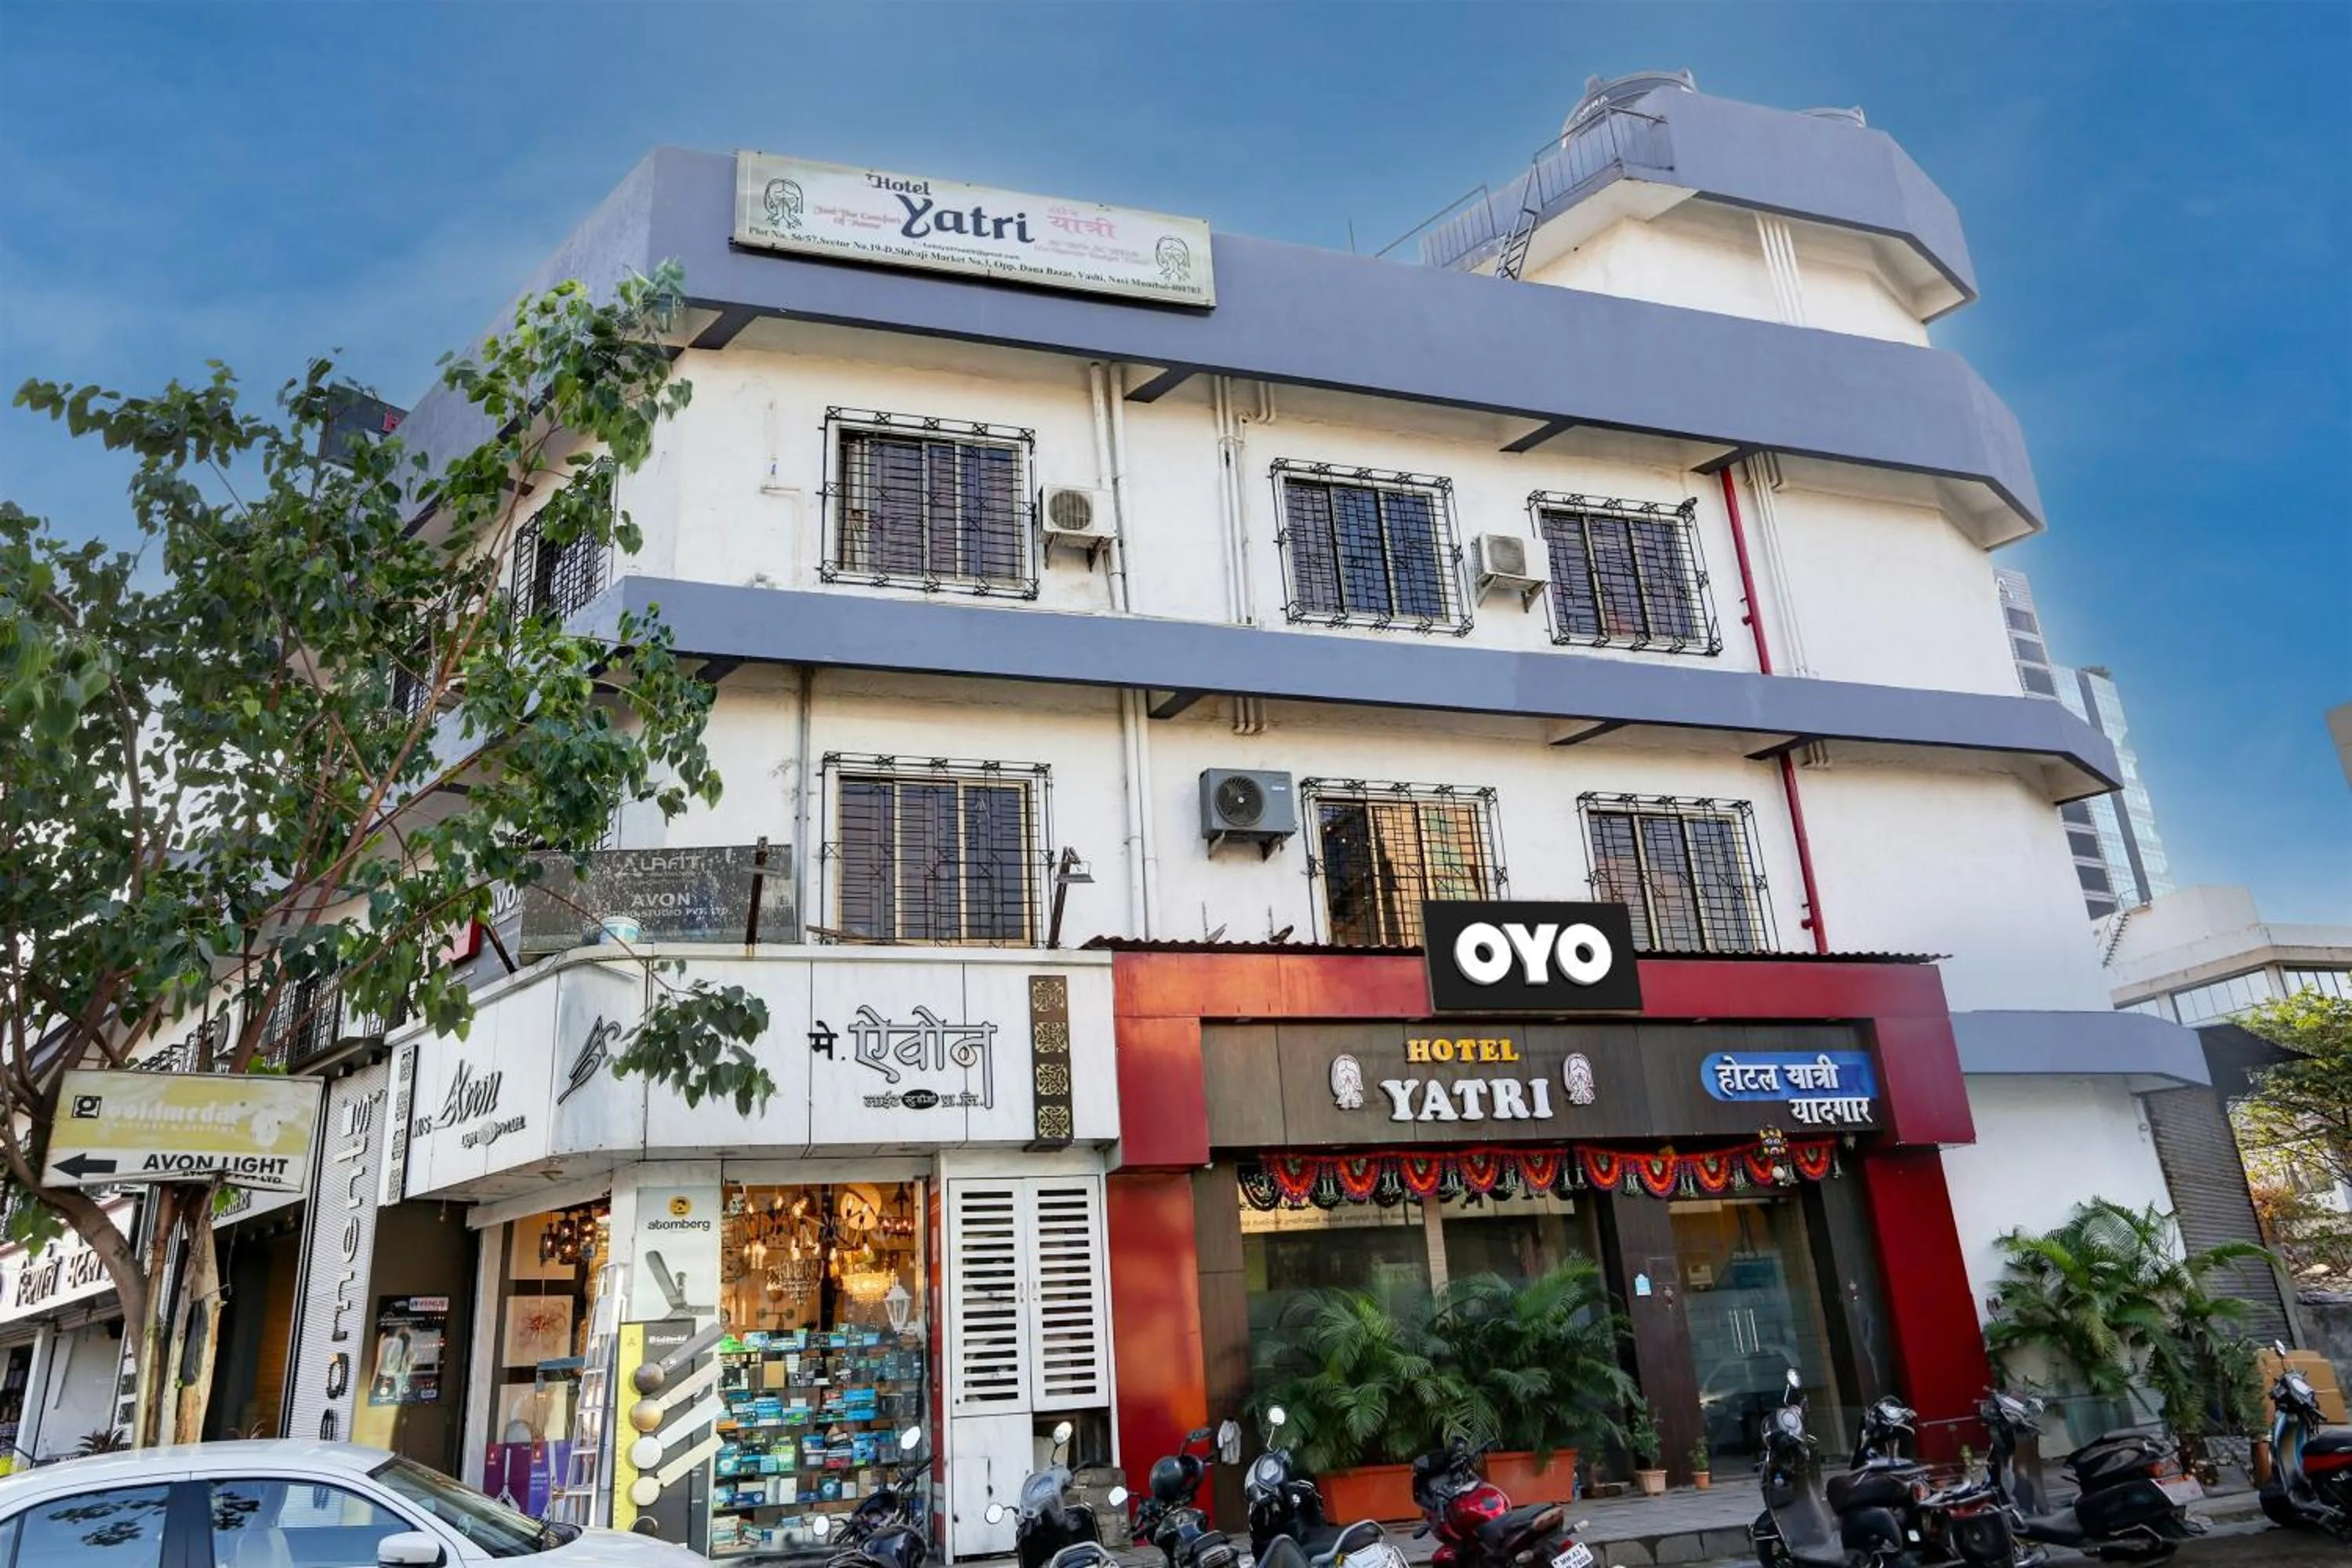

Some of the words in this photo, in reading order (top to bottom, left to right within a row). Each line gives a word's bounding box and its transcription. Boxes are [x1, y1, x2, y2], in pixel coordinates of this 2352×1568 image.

[866, 173, 931, 195] Hotel
[895, 193, 1036, 244] Yatri
[1046, 215, 1117, 241] यात्री
[749, 226, 768, 236] Plot
[931, 252, 965, 264] Market
[1108, 275, 1130, 285] Navi
[630, 891, 691, 908] AVON
[1454, 921, 1613, 986] OYO
[1406, 1038, 1520, 1064] HOTEL
[1715, 1055, 1781, 1096] होटल
[1782, 1053, 1839, 1090] यात्री
[1379, 1078, 1554, 1121] YATRI
[1788, 1097, 1873, 1124] यादगार
[143, 1154, 213, 1171] AVON
[221, 1156, 289, 1176] LIGHT
[647, 1218, 711, 1232] atomberg
